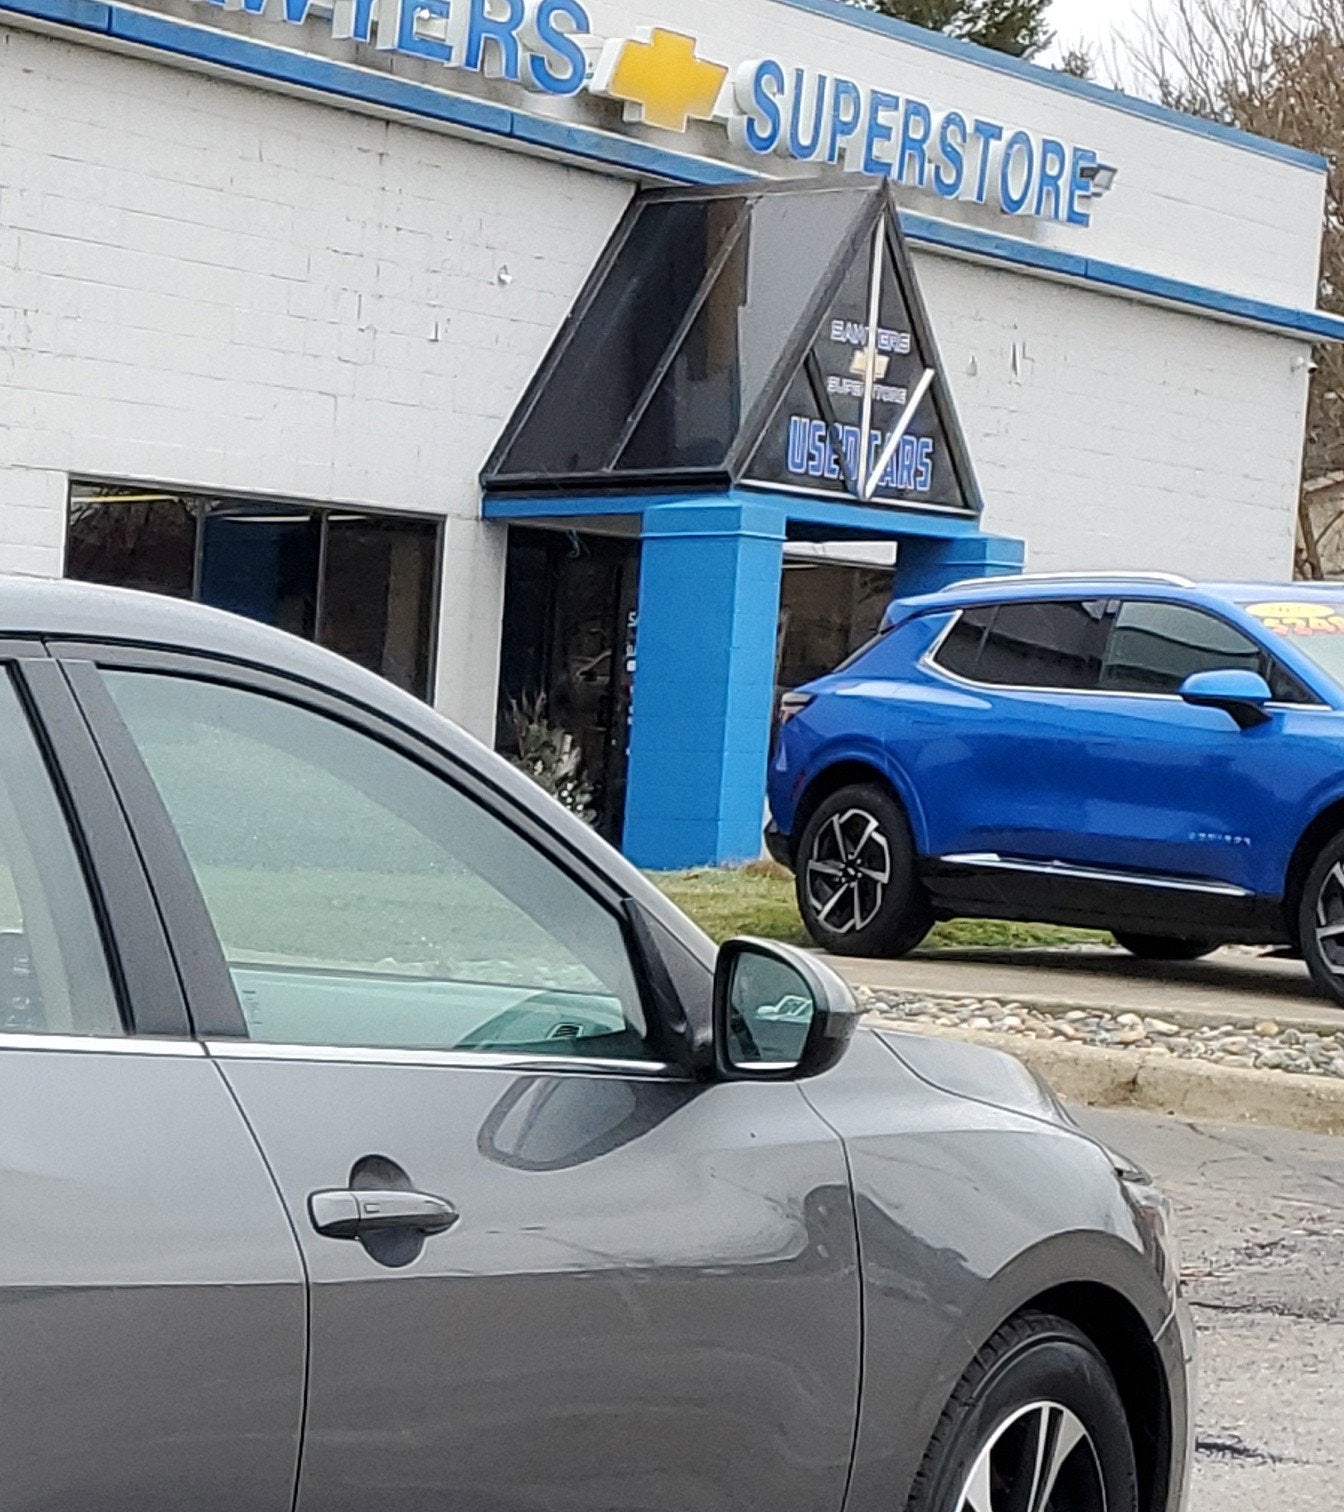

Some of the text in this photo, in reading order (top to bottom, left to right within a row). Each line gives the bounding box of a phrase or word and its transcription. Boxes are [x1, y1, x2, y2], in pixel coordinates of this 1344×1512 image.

[744, 58, 1098, 228] SUPERSTORE
[829, 319, 911, 355] SAWERS
[787, 416, 861, 482] USED
